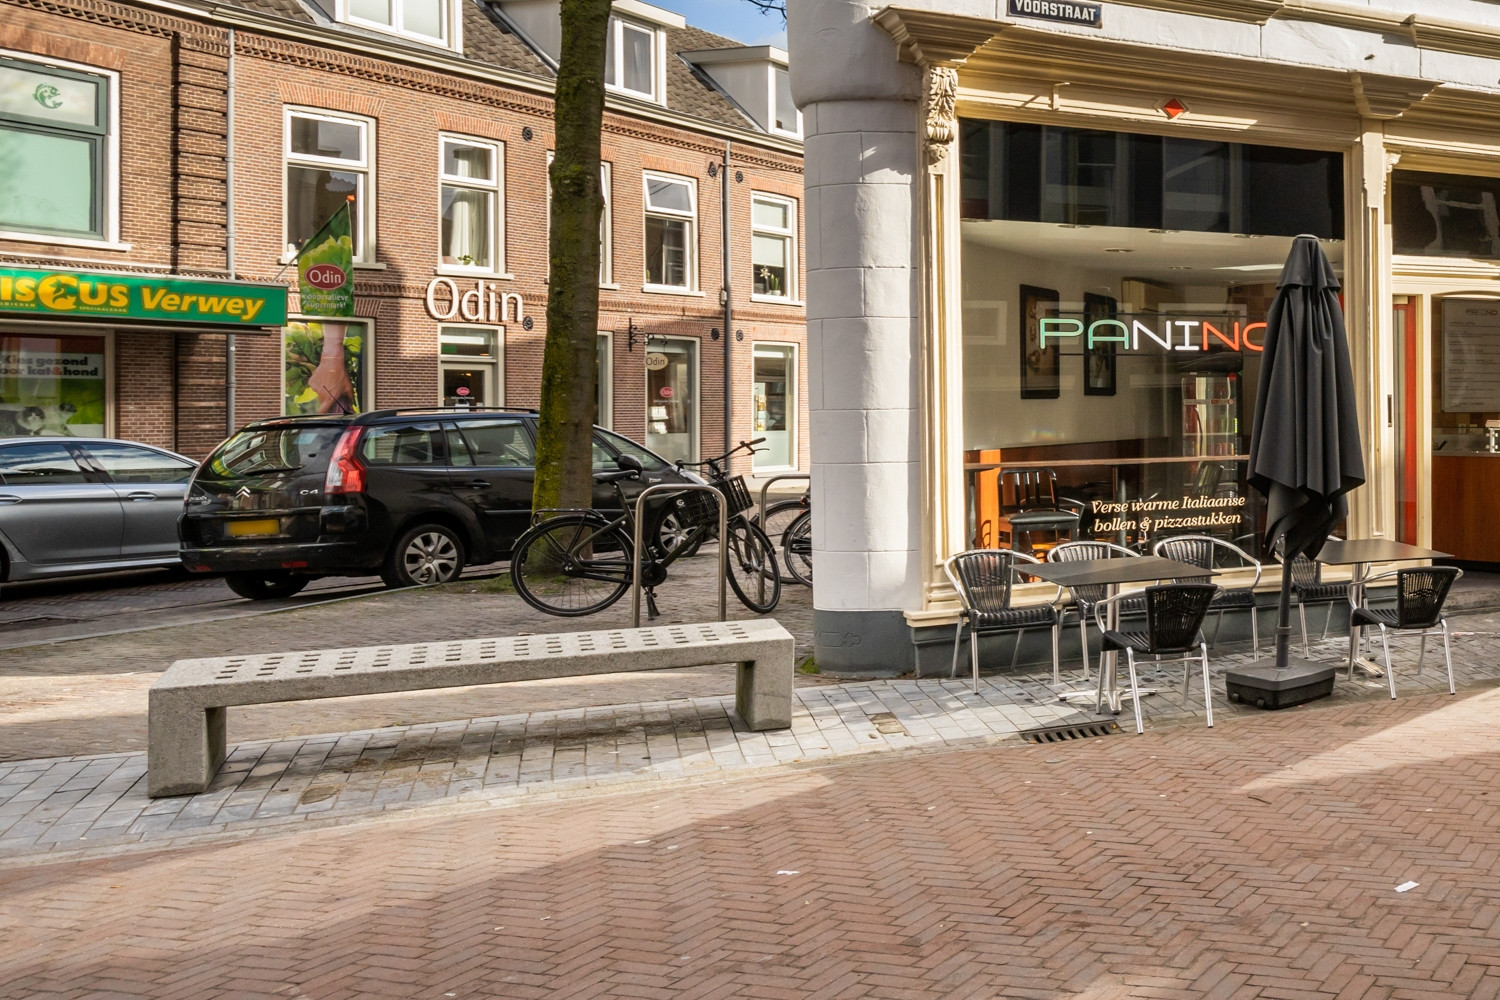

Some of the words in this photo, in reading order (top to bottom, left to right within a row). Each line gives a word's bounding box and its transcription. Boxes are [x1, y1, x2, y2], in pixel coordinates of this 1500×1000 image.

[309, 269, 342, 284] Odin
[0, 275, 129, 311] ISCUS
[140, 287, 265, 321] Verwey
[426, 277, 524, 322] Odin
[36, 357, 88, 367] gezond
[646, 356, 665, 366] Odin
[0, 367, 23, 375] oor
[1091, 498, 1129, 514] Verse
[1131, 501, 1180, 512] warme
[1181, 495, 1246, 509] Italiaanse
[1094, 518, 1136, 532] bollen
[1139, 516, 1152, 532] &
[1153, 512, 1242, 532] pizzastukken
